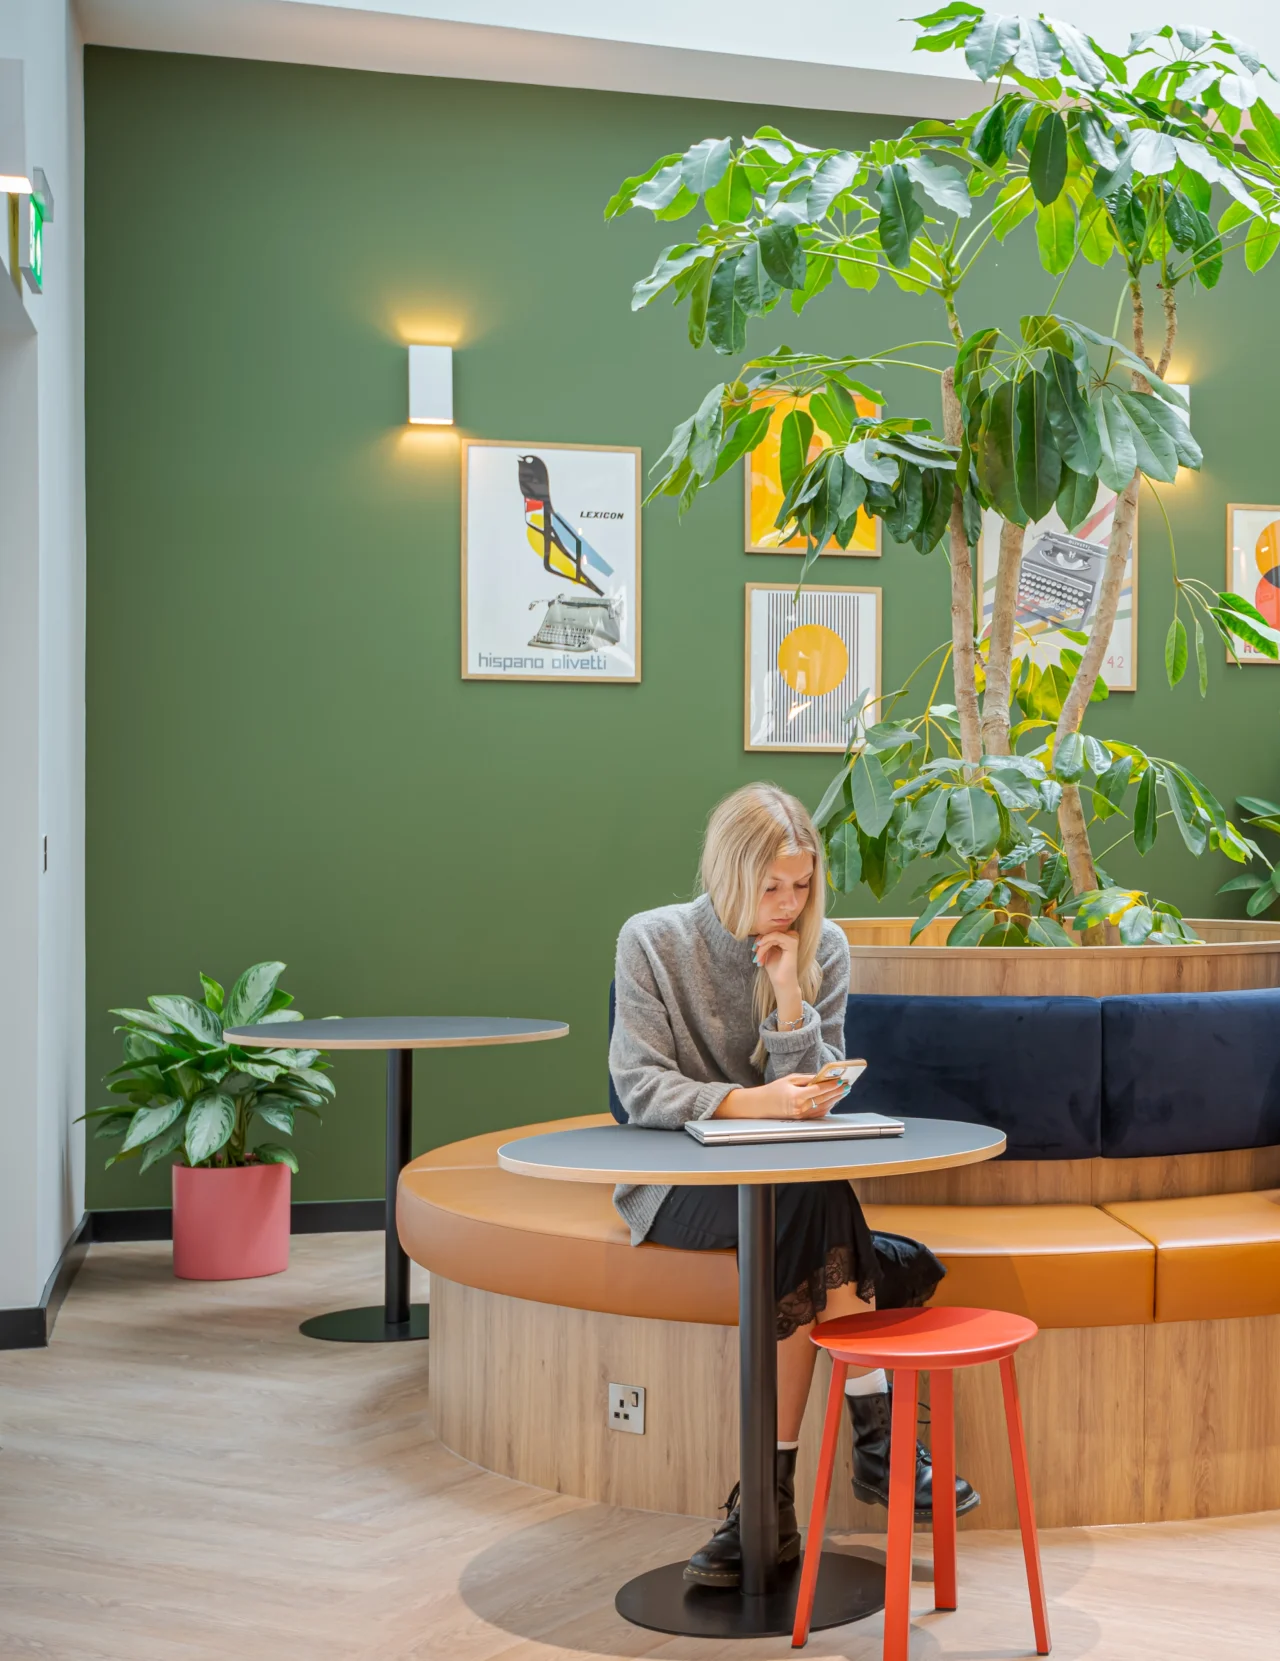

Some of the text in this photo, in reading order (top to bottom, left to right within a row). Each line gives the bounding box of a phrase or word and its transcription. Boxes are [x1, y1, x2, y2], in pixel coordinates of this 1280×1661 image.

[580, 510, 624, 520] LEXICON
[478, 652, 607, 671] hispano olivetti
[1107, 655, 1124, 668] 42
